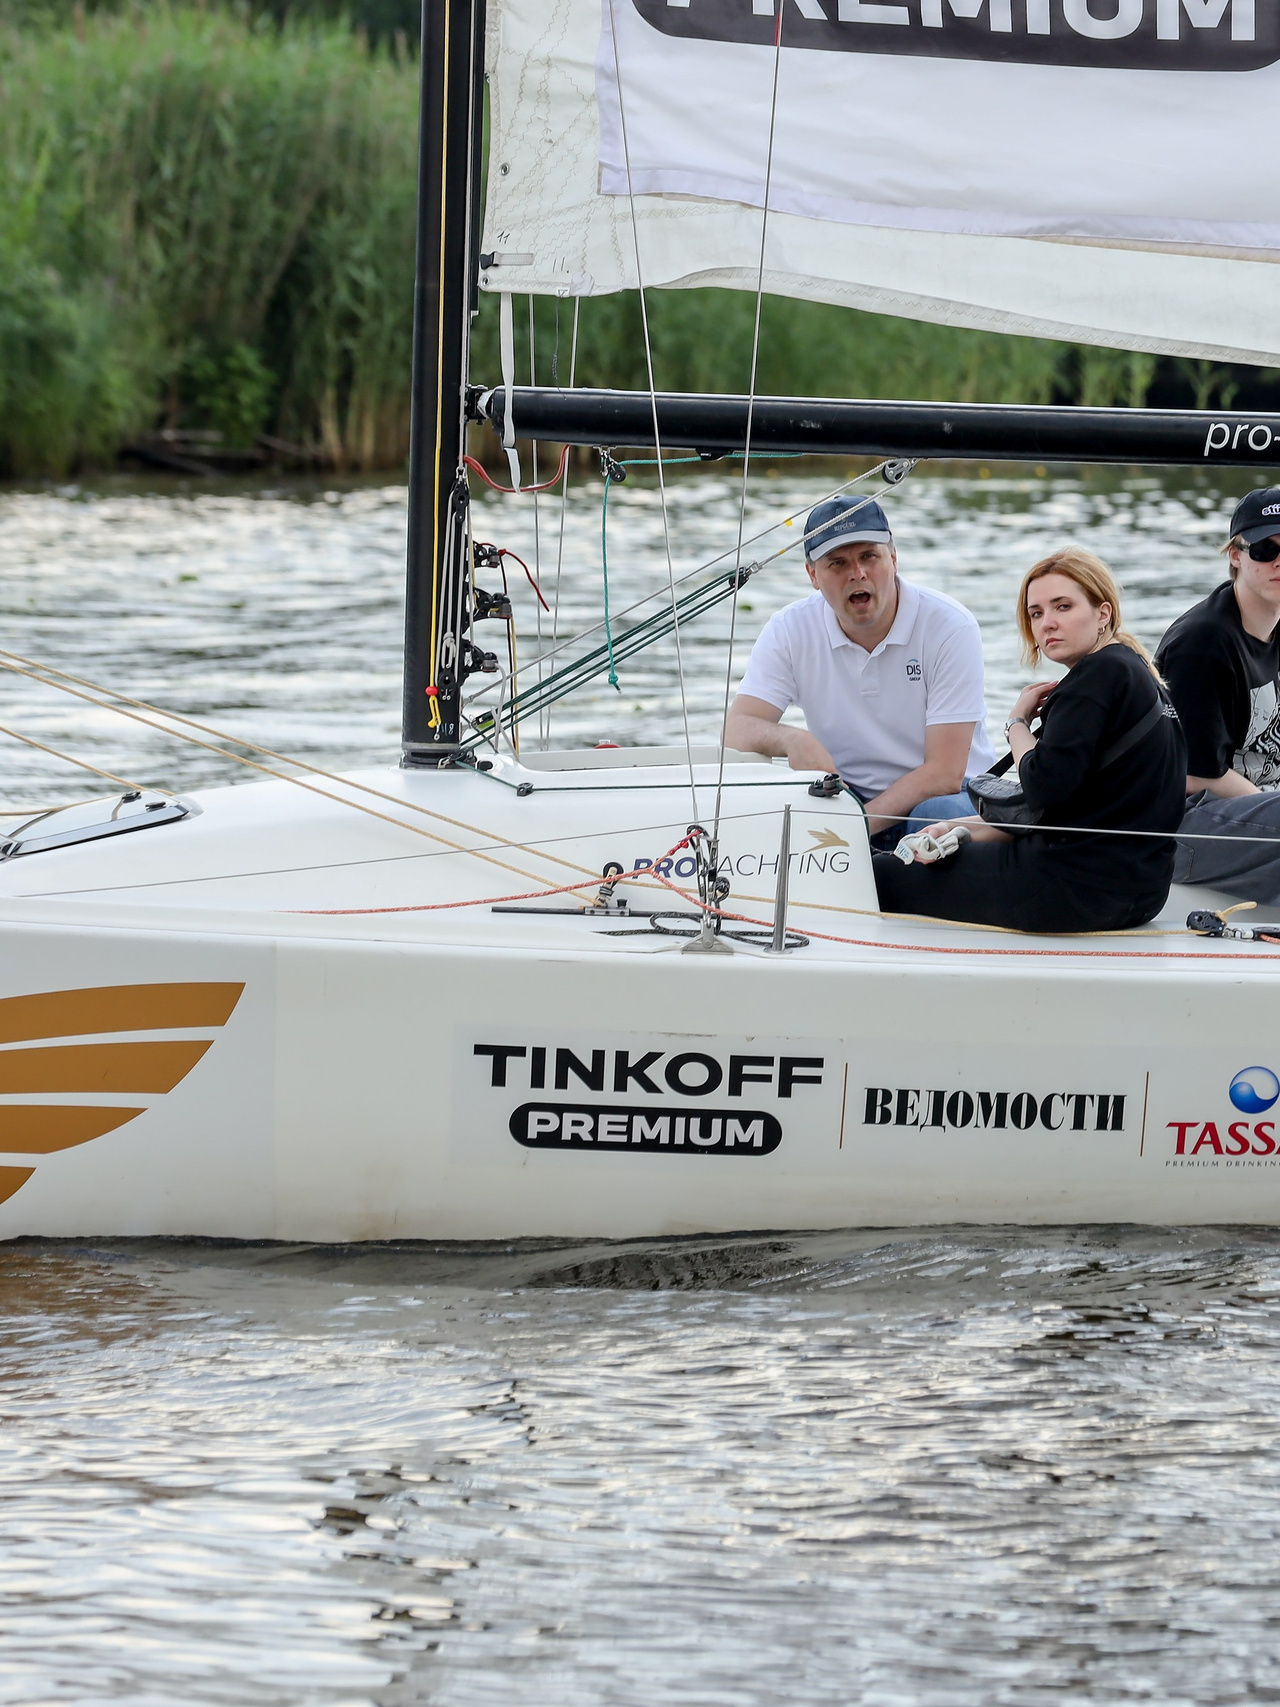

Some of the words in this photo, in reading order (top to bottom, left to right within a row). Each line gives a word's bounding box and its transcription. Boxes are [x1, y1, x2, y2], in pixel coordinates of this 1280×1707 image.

[905, 664, 922, 676] DIS
[631, 851, 850, 880] PROACHTING
[473, 1043, 825, 1099] TINKOFF
[526, 1110, 765, 1148] PREMIUM
[861, 1086, 1128, 1134] ВЕДОМОСТИ
